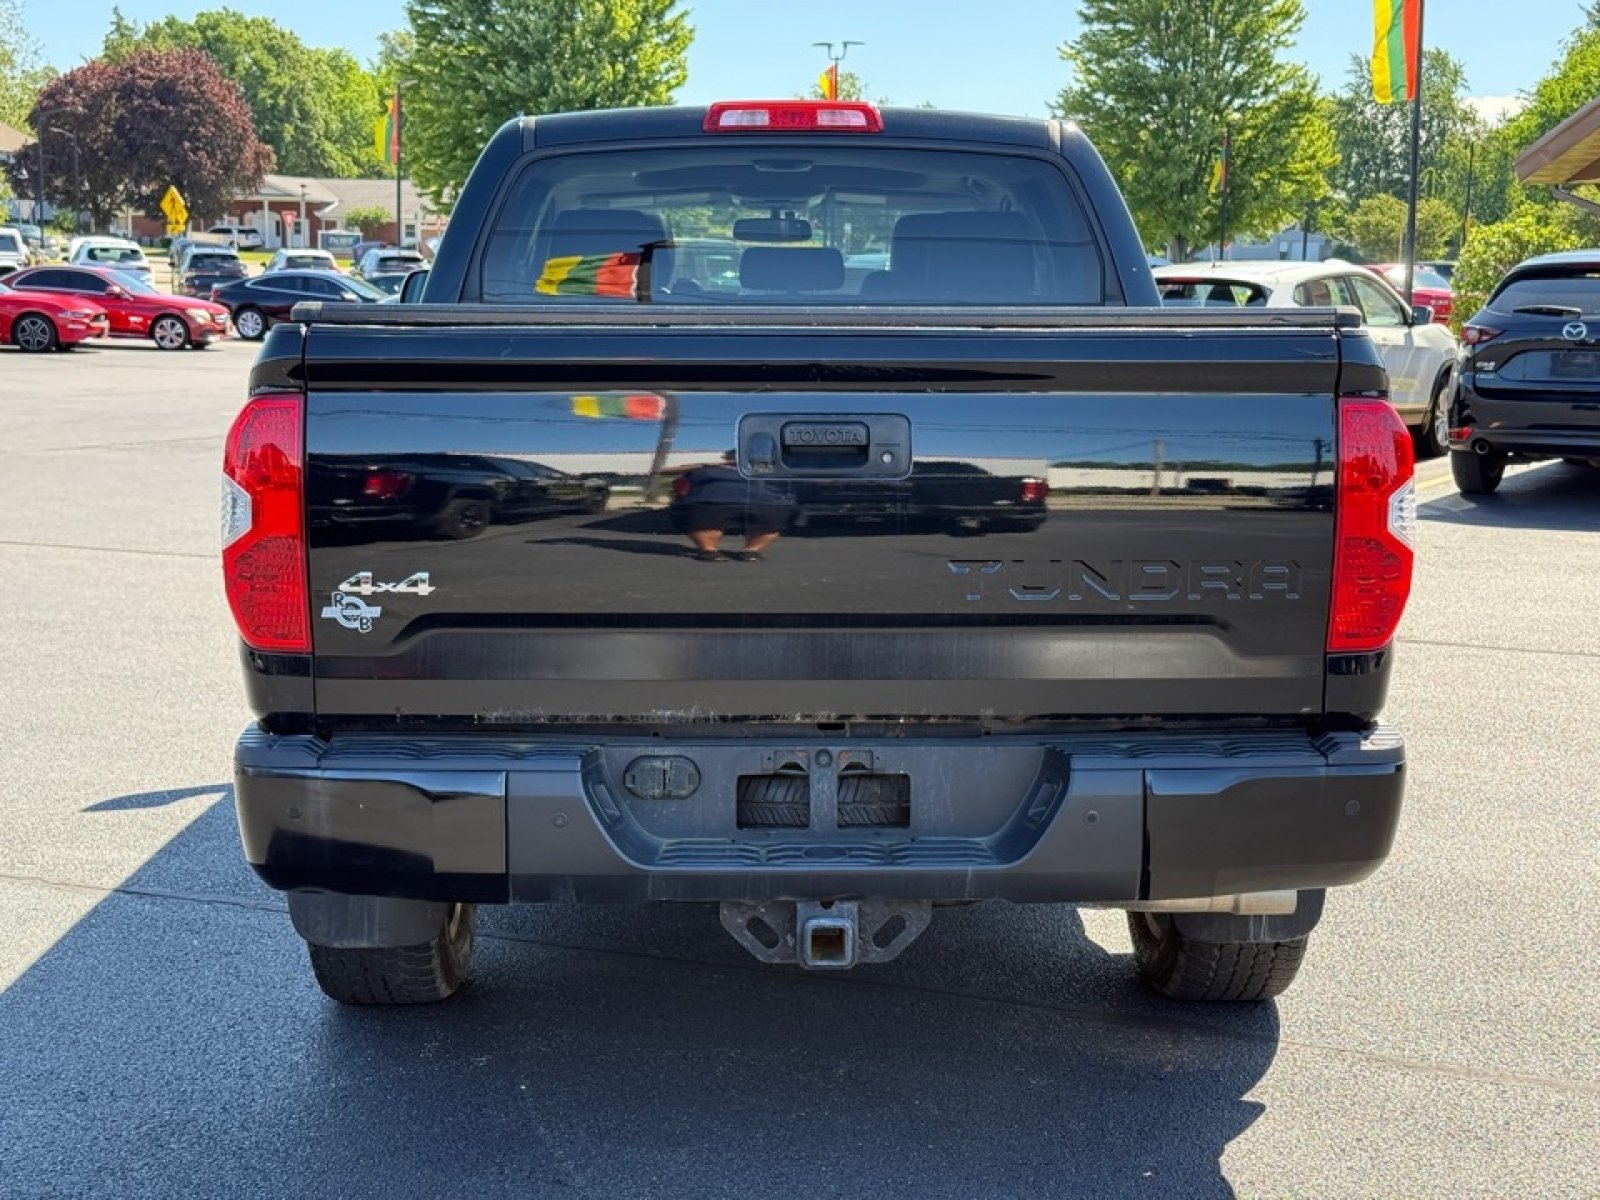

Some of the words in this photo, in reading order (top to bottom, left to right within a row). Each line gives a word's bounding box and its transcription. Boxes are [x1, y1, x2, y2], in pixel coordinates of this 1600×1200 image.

[790, 429, 862, 444] TOYOTA
[338, 571, 436, 596] 4x4
[947, 559, 1304, 601] TUNDRA
